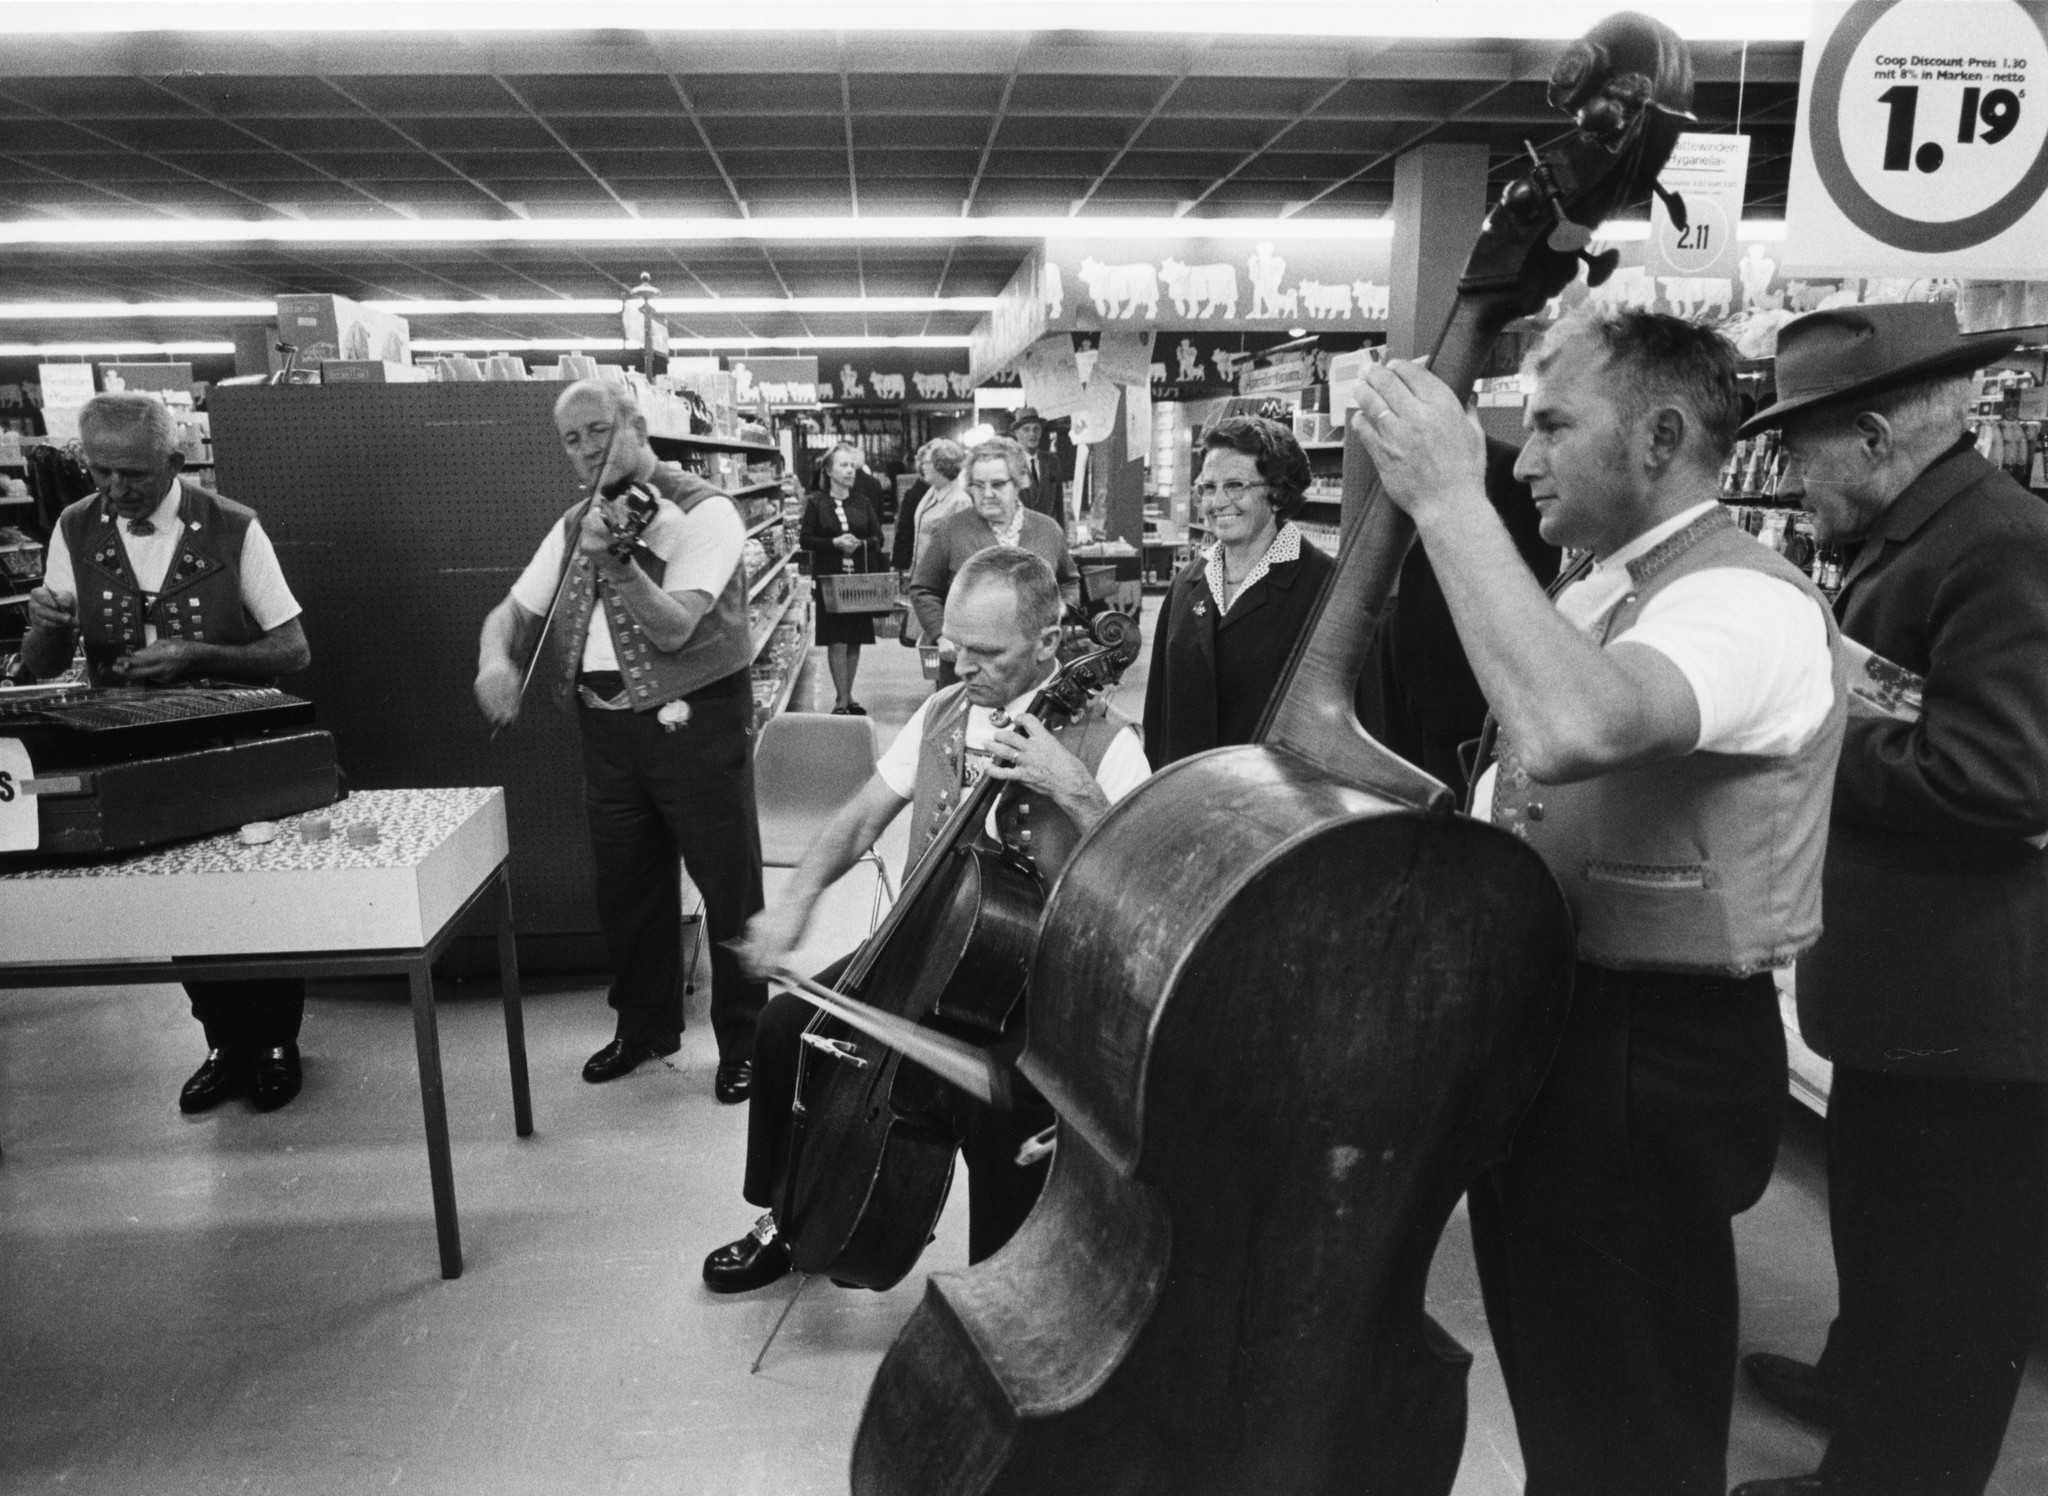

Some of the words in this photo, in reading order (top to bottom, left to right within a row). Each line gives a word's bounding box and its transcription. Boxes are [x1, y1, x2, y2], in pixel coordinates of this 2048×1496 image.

[1875, 55, 1907, 69] Coop
[2003, 58, 2027, 69] 1.30
[1874, 69, 1896, 80] mit
[1900, 69, 1918, 80] 8%
[1921, 70, 1933, 80] in
[1936, 70, 1982, 81] Marken
[1993, 73, 2025, 82] netto
[1677, 224, 1710, 249] 2.11
